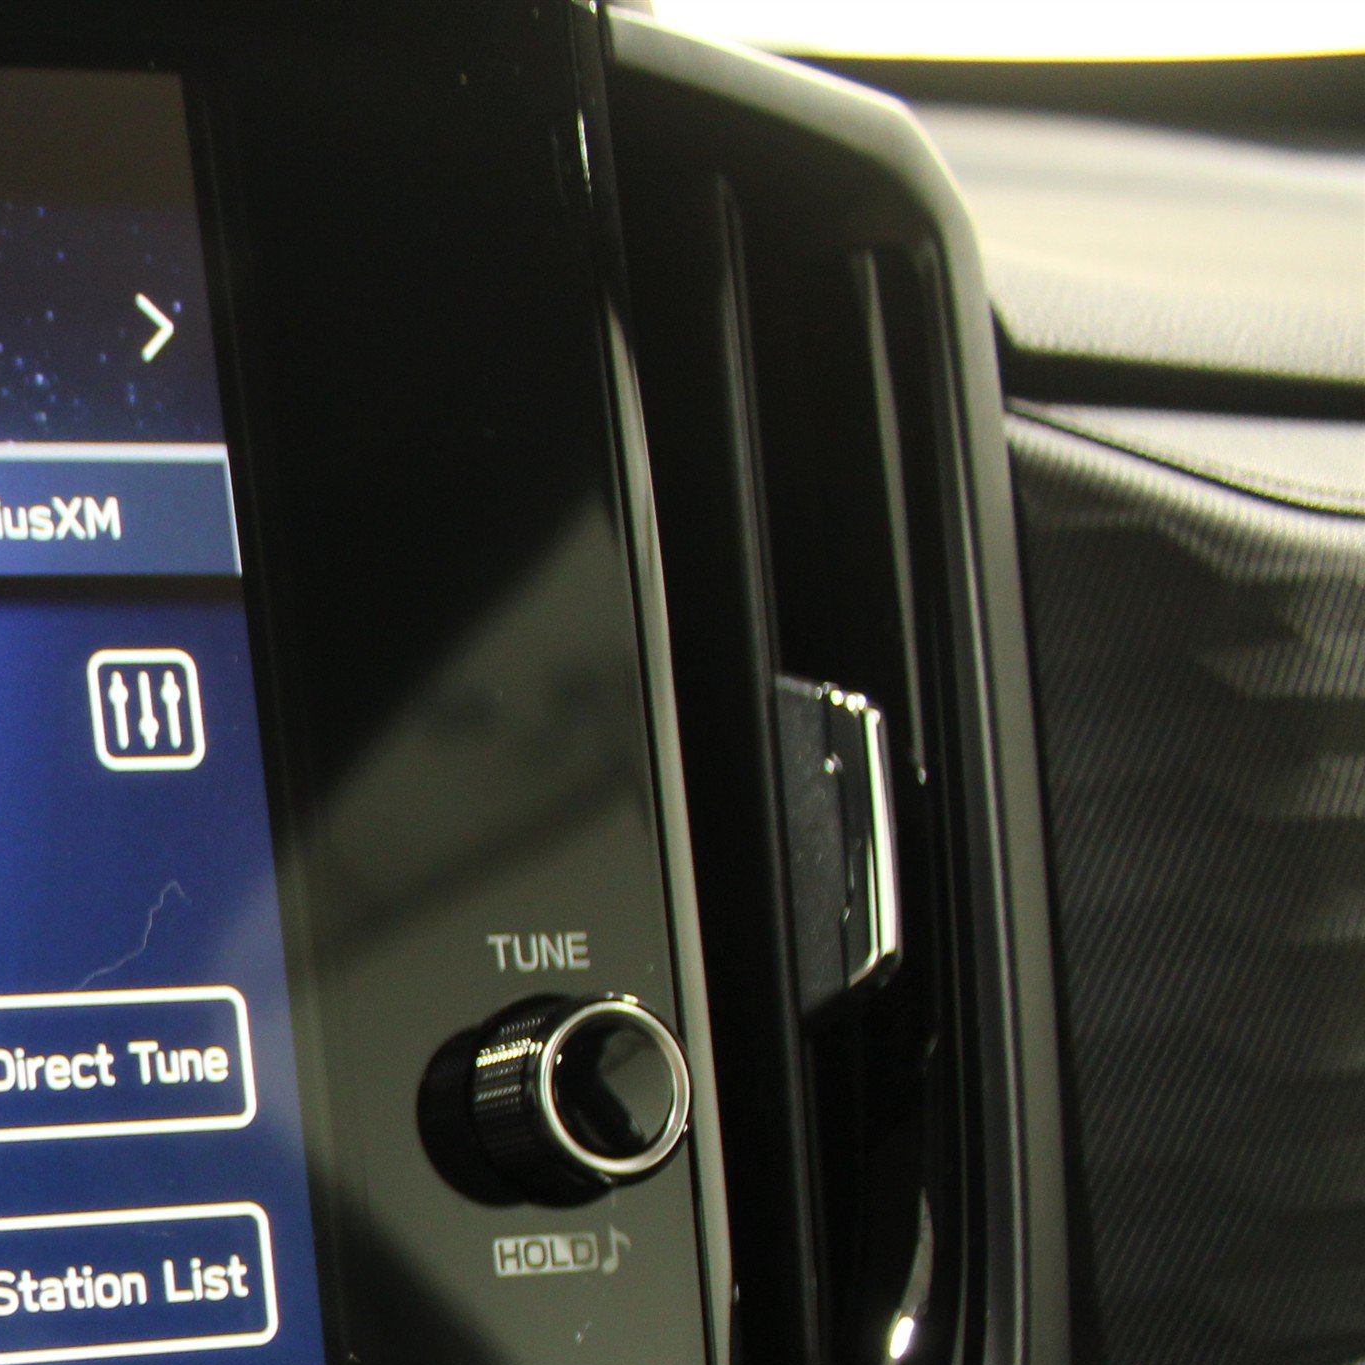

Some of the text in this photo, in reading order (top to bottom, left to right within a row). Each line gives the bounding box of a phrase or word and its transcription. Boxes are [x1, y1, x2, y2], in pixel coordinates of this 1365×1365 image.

[487, 931, 591, 973] TUNE
[128, 1038, 230, 1086] Tune
[495, 1232, 597, 1275] HOLD
[161, 1254, 251, 1304] List
